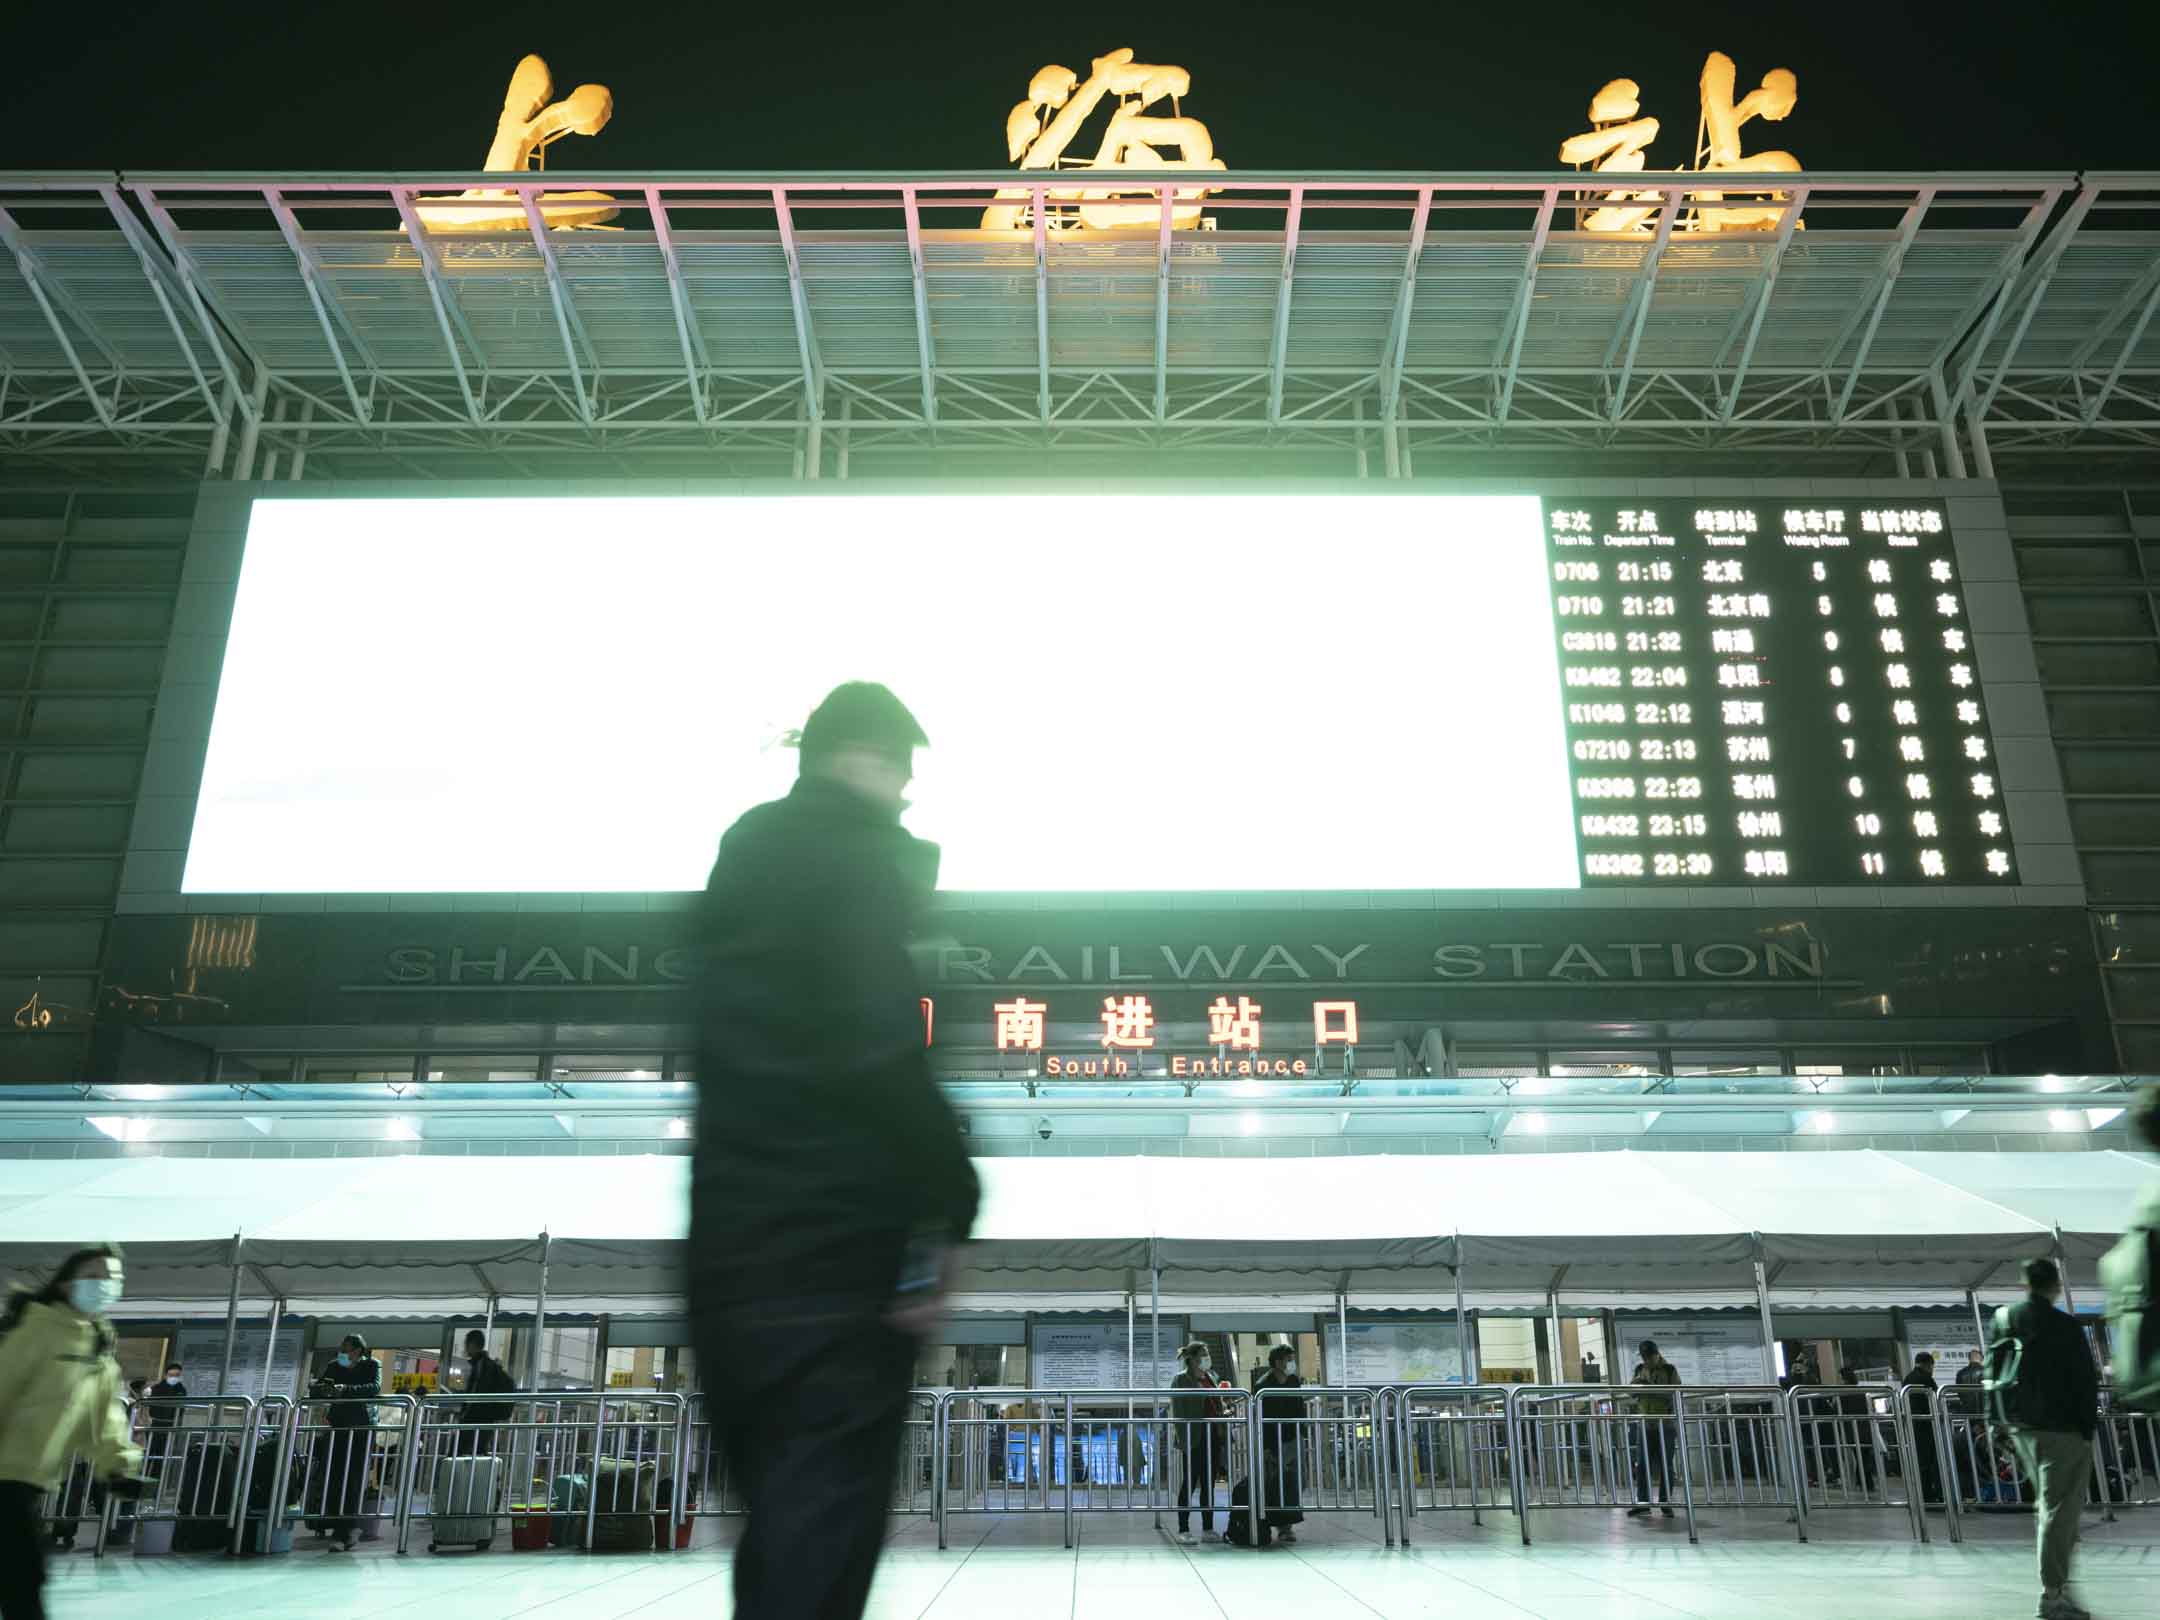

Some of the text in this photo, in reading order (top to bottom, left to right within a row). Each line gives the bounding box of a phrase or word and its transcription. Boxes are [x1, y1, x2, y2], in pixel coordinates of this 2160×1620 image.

[1550, 510, 1592, 532] 车次
[1618, 510, 1658, 531] 开点
[1784, 510, 1845, 532] 候车厅
[1862, 510, 1942, 532] 当前状态
[1784, 535, 1849, 548] Waiting Room
[1888, 535, 1918, 546] Status
[1618, 562, 1672, 581] 21:15
[1703, 560, 1743, 582] 北京
[1557, 596, 1603, 615] D710
[1622, 596, 1674, 615] 21:21
[1707, 593, 1770, 617] 北京南
[1626, 632, 1681, 651] 21:32
[1630, 667, 1686, 687] 22:04
[1635, 703, 1691, 723] 22:12
[1640, 739, 1696, 760] 22:13
[1726, 736, 1770, 761] 苏州
[1644, 777, 1701, 798] 22:23
[1649, 815, 1706, 836] 23:15
[1856, 814, 1880, 835] 10
[1654, 854, 1712, 875] 23:30
[1862, 853, 1883, 874] 11
[937, 944, 1370, 981] RAILWAY
[1431, 943, 1822, 978] STATION
[994, 996, 1360, 1049] 南进站口
[1046, 1056, 1306, 1076] South Entrance
